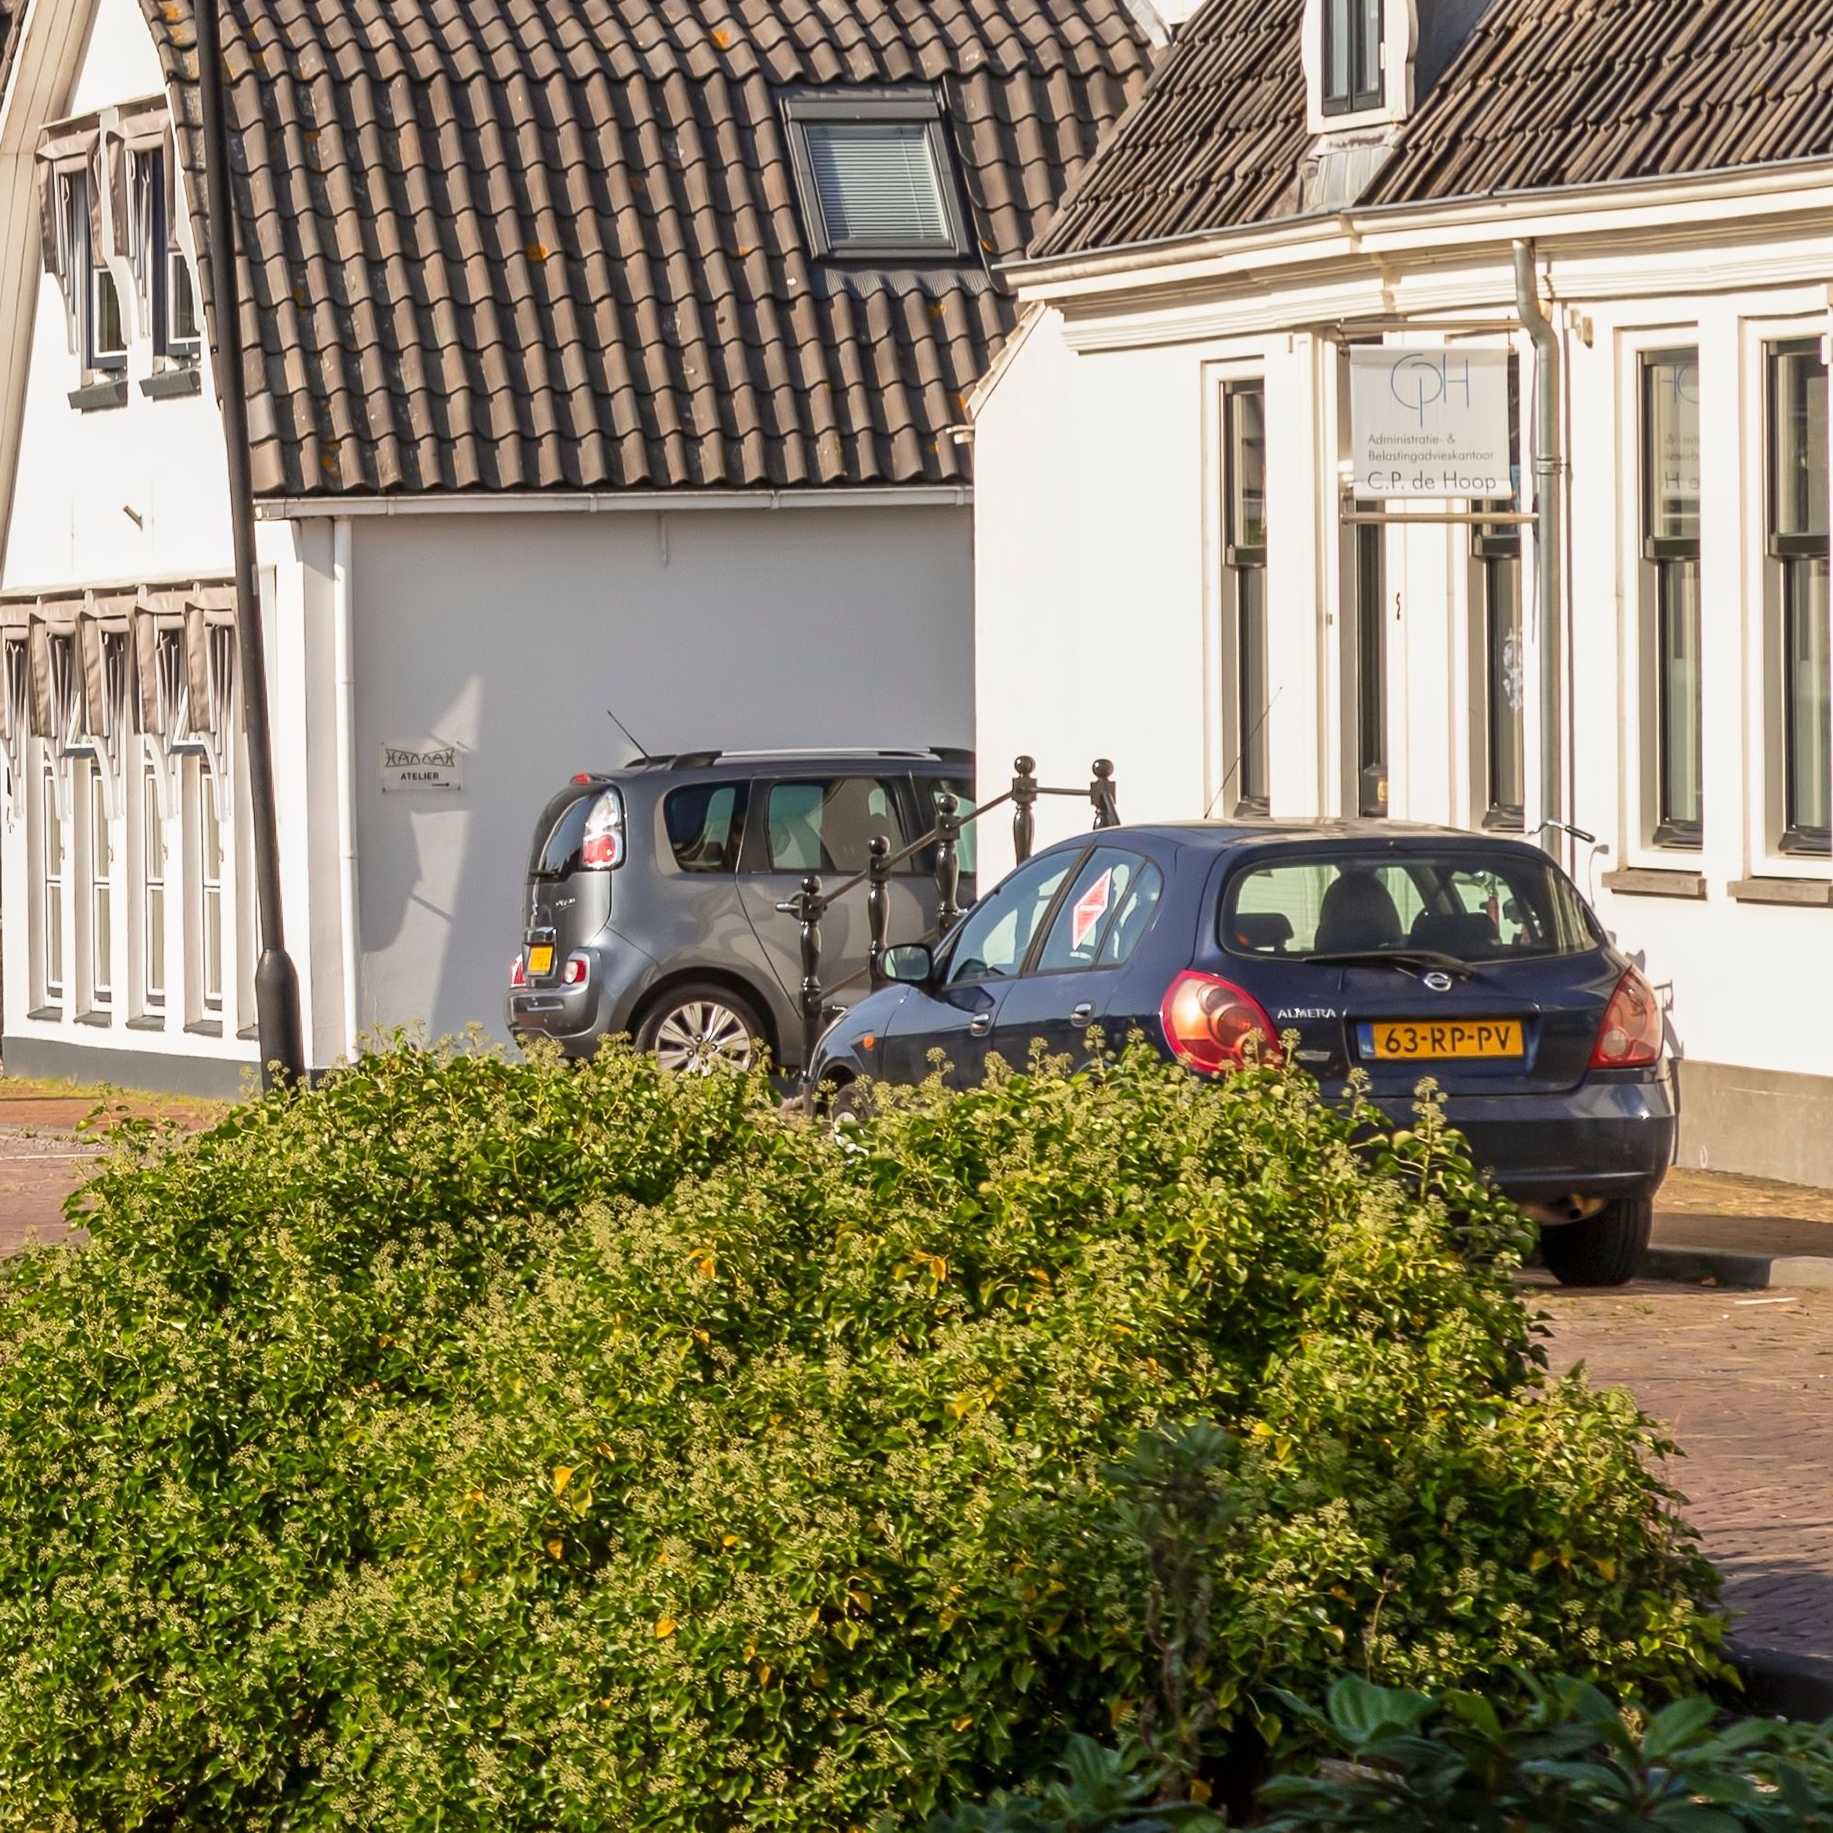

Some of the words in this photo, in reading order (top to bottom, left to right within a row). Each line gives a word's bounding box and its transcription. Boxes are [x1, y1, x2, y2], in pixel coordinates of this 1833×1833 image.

[1367, 433, 1443, 445] Administratie-
[1446, 433, 1456, 445] &
[1368, 449, 1495, 463] Belastingadvieskantoor
[1367, 470, 1405, 490] C.P.
[1412, 470, 1435, 490] de
[1443, 470, 1496, 493] Hoop
[400, 771, 440, 781] ATELIER
[1277, 1007, 1337, 1020] ALMERA
[1384, 1025, 1511, 1054] 63-RP-PV
